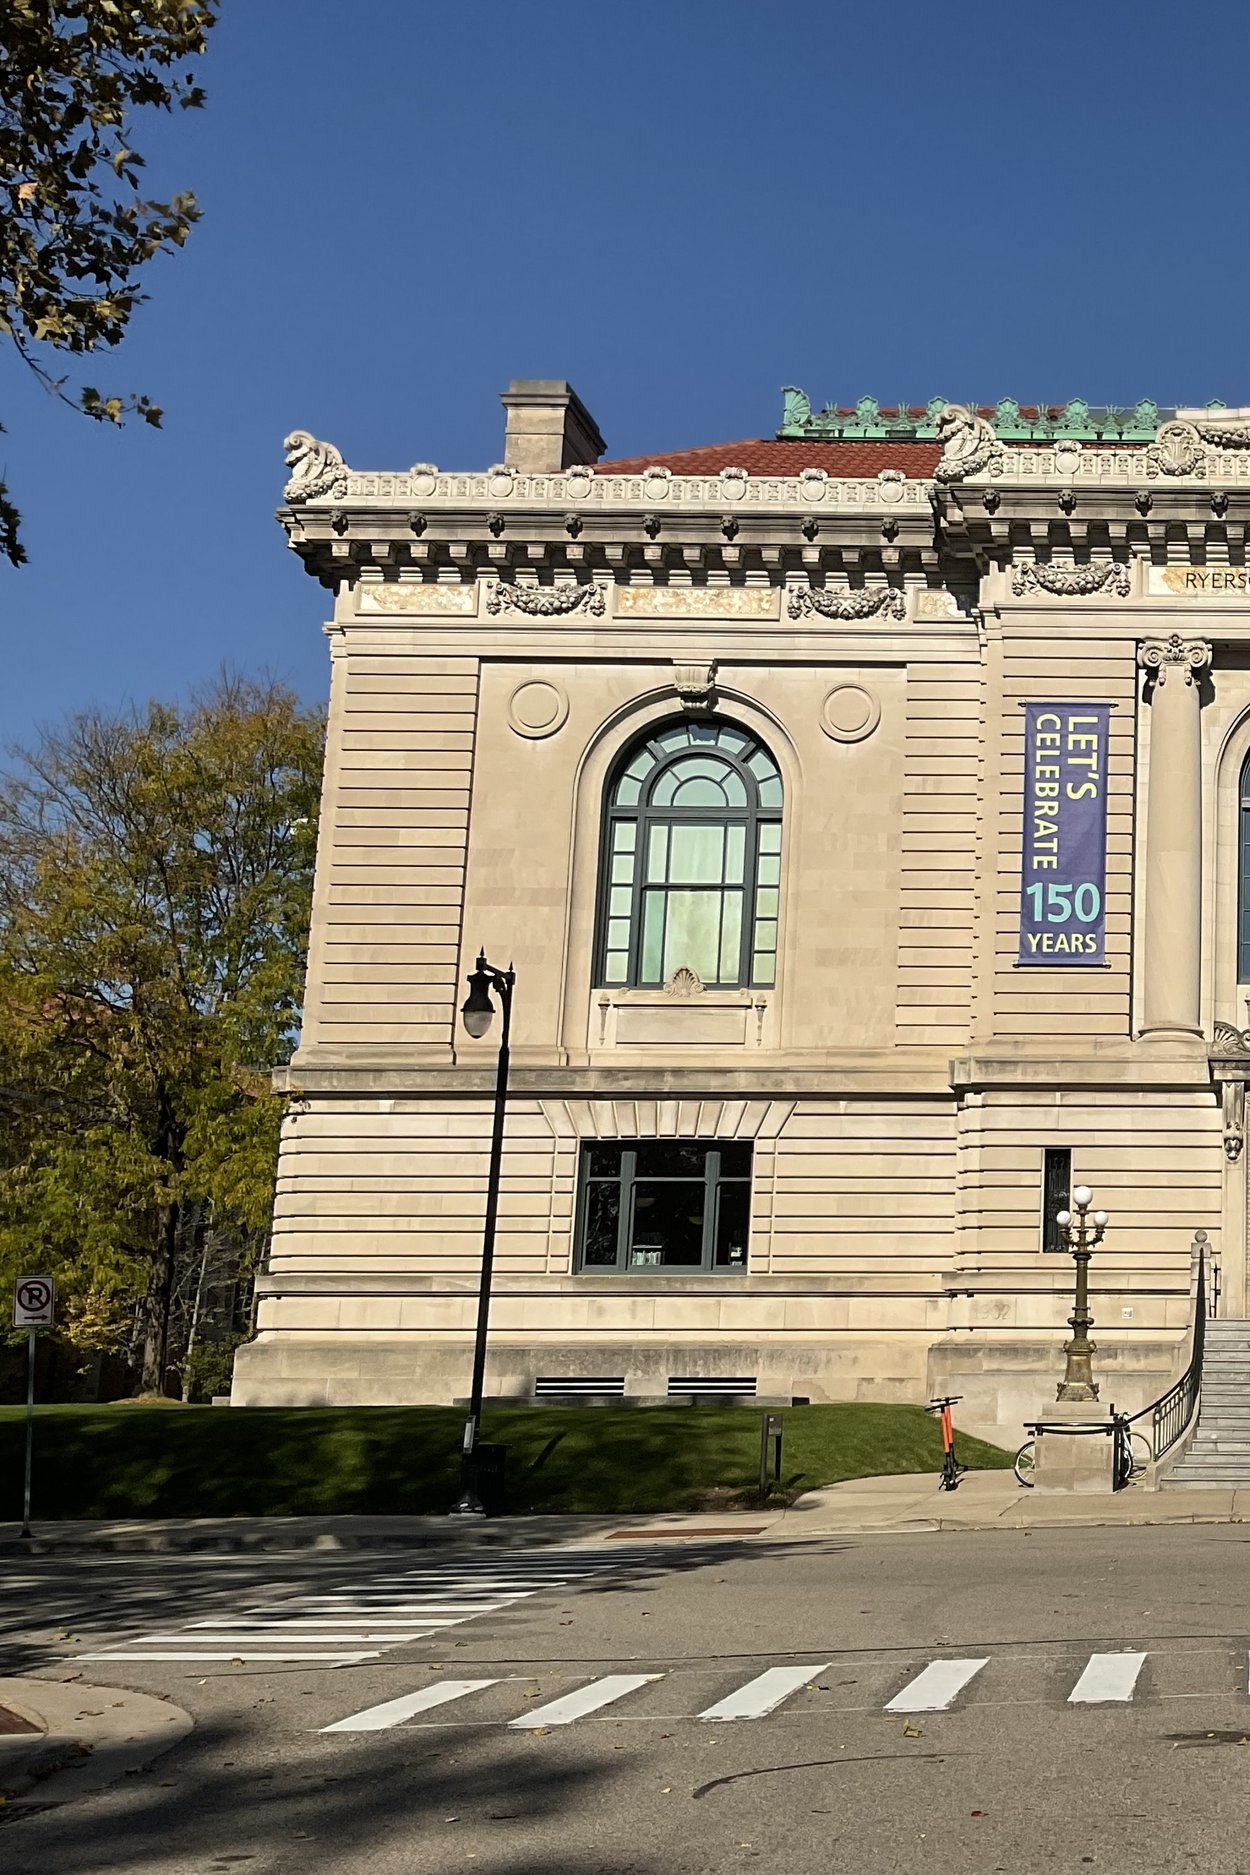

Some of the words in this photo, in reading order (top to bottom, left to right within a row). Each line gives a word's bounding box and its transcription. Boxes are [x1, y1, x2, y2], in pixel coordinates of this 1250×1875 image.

[1066, 716, 1100, 800] LET'S
[1033, 713, 1061, 870] CELEBRATE
[1026, 882, 1101, 923] 150
[1027, 933, 1097, 954] YEARS
